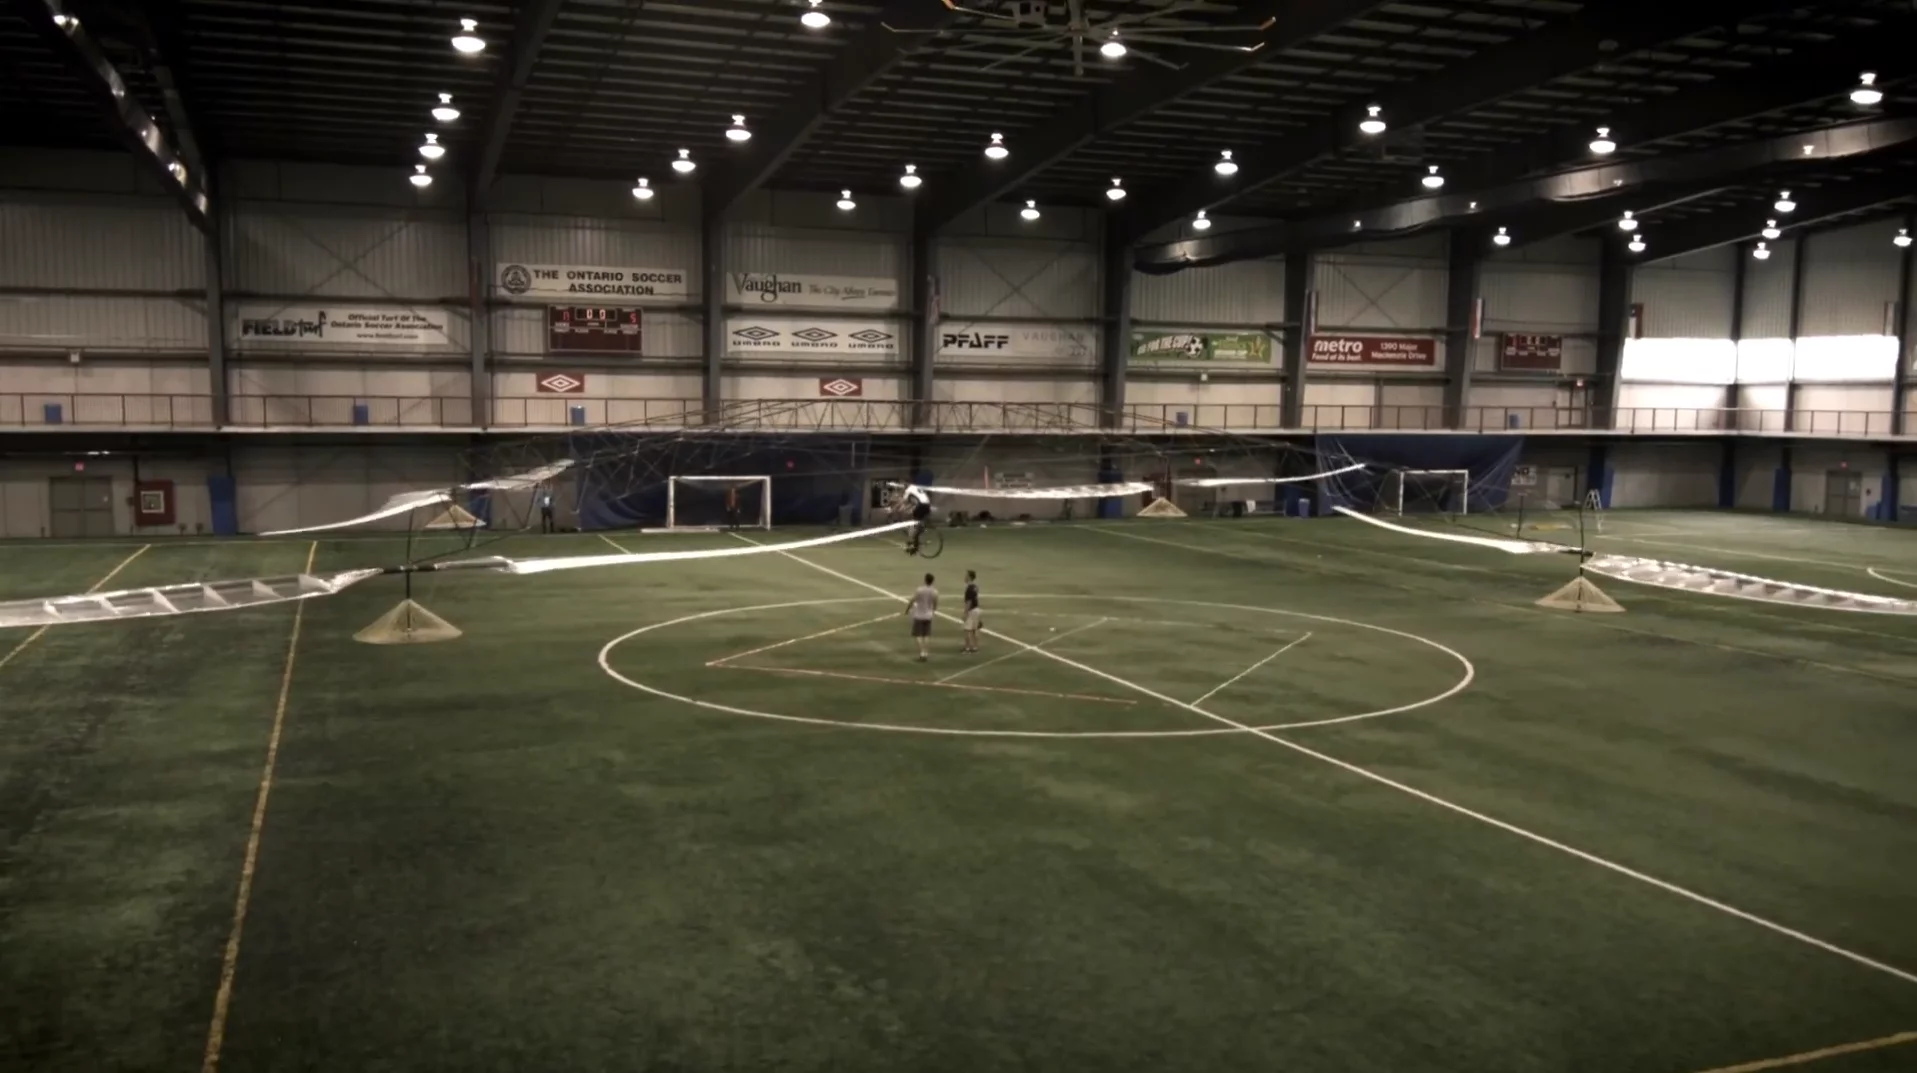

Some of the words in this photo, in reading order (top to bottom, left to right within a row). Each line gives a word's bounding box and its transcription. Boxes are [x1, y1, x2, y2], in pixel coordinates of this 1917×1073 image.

[533, 269, 559, 280] THE
[566, 270, 625, 282] ONTARIO
[631, 272, 683, 284] SOCCER
[568, 283, 655, 296] ASSOCIATION
[731, 273, 803, 303] Vaughan
[943, 332, 1009, 349] PFAFF
[1313, 338, 1363, 353] metro
